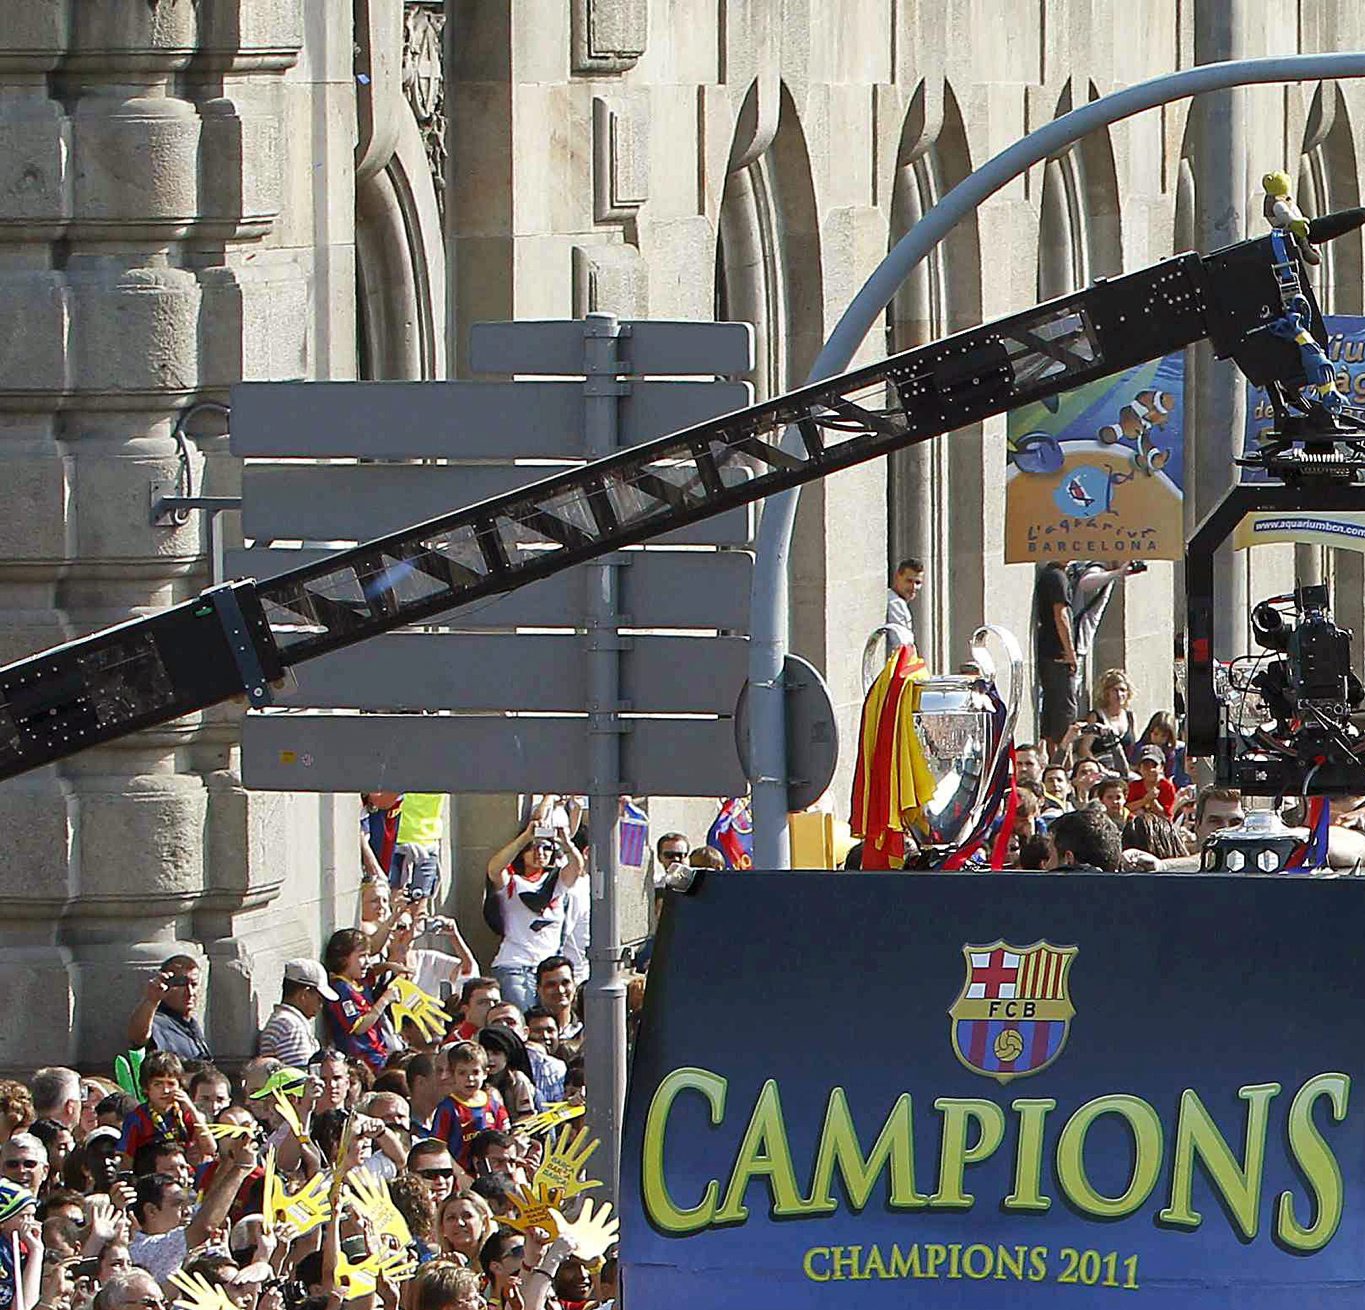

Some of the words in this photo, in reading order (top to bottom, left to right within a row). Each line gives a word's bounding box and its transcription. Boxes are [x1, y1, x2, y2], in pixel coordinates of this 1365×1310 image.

[1028, 541, 1157, 551] BARCELONA
[987, 1001, 1037, 1019] FCB
[641, 1066, 1353, 1254] CAMPIONS
[803, 1243, 1047, 1283] CHAMPIONS
[1059, 1248, 1140, 1290] 2011
